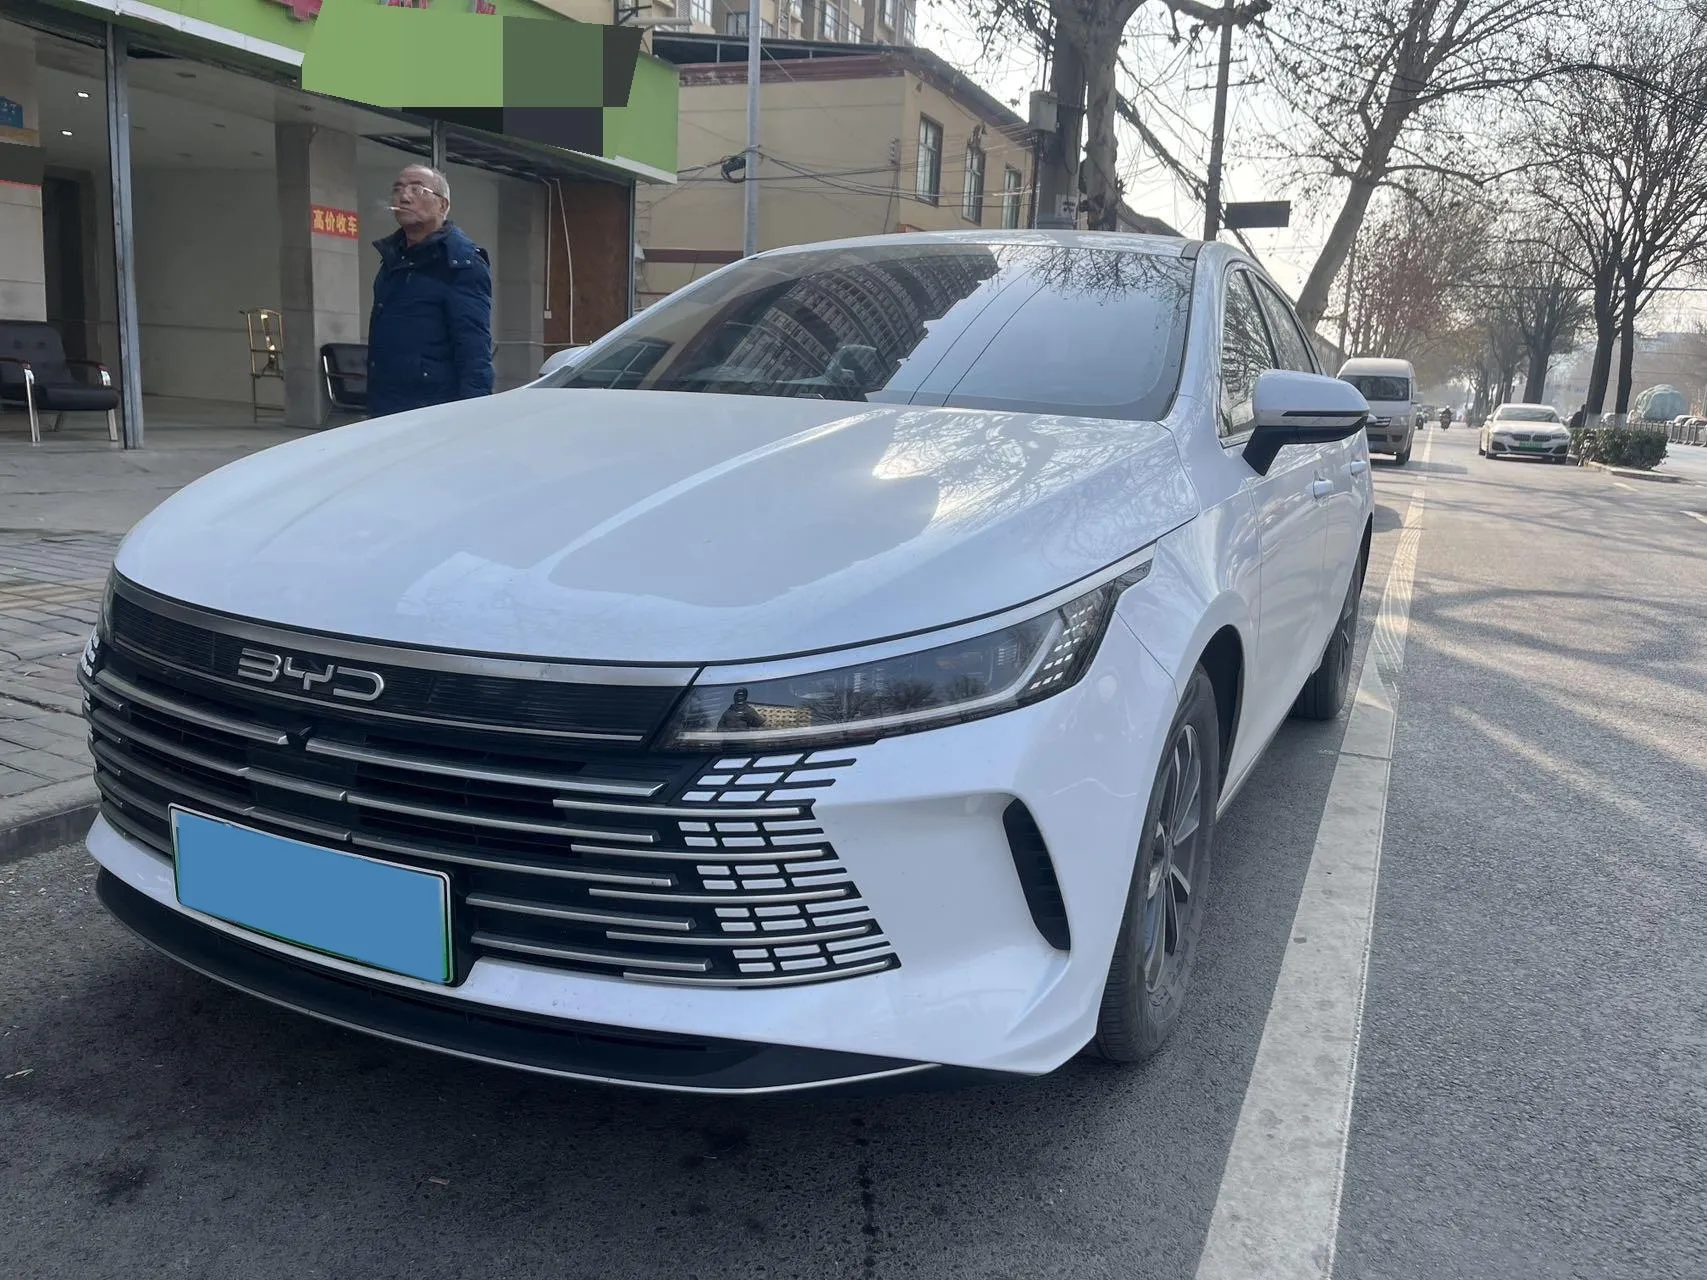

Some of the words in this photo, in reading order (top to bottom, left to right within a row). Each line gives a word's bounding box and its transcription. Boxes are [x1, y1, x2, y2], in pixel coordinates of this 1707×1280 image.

[313, 209, 357, 236] 高价收车
[238, 648, 384, 701] BYD
